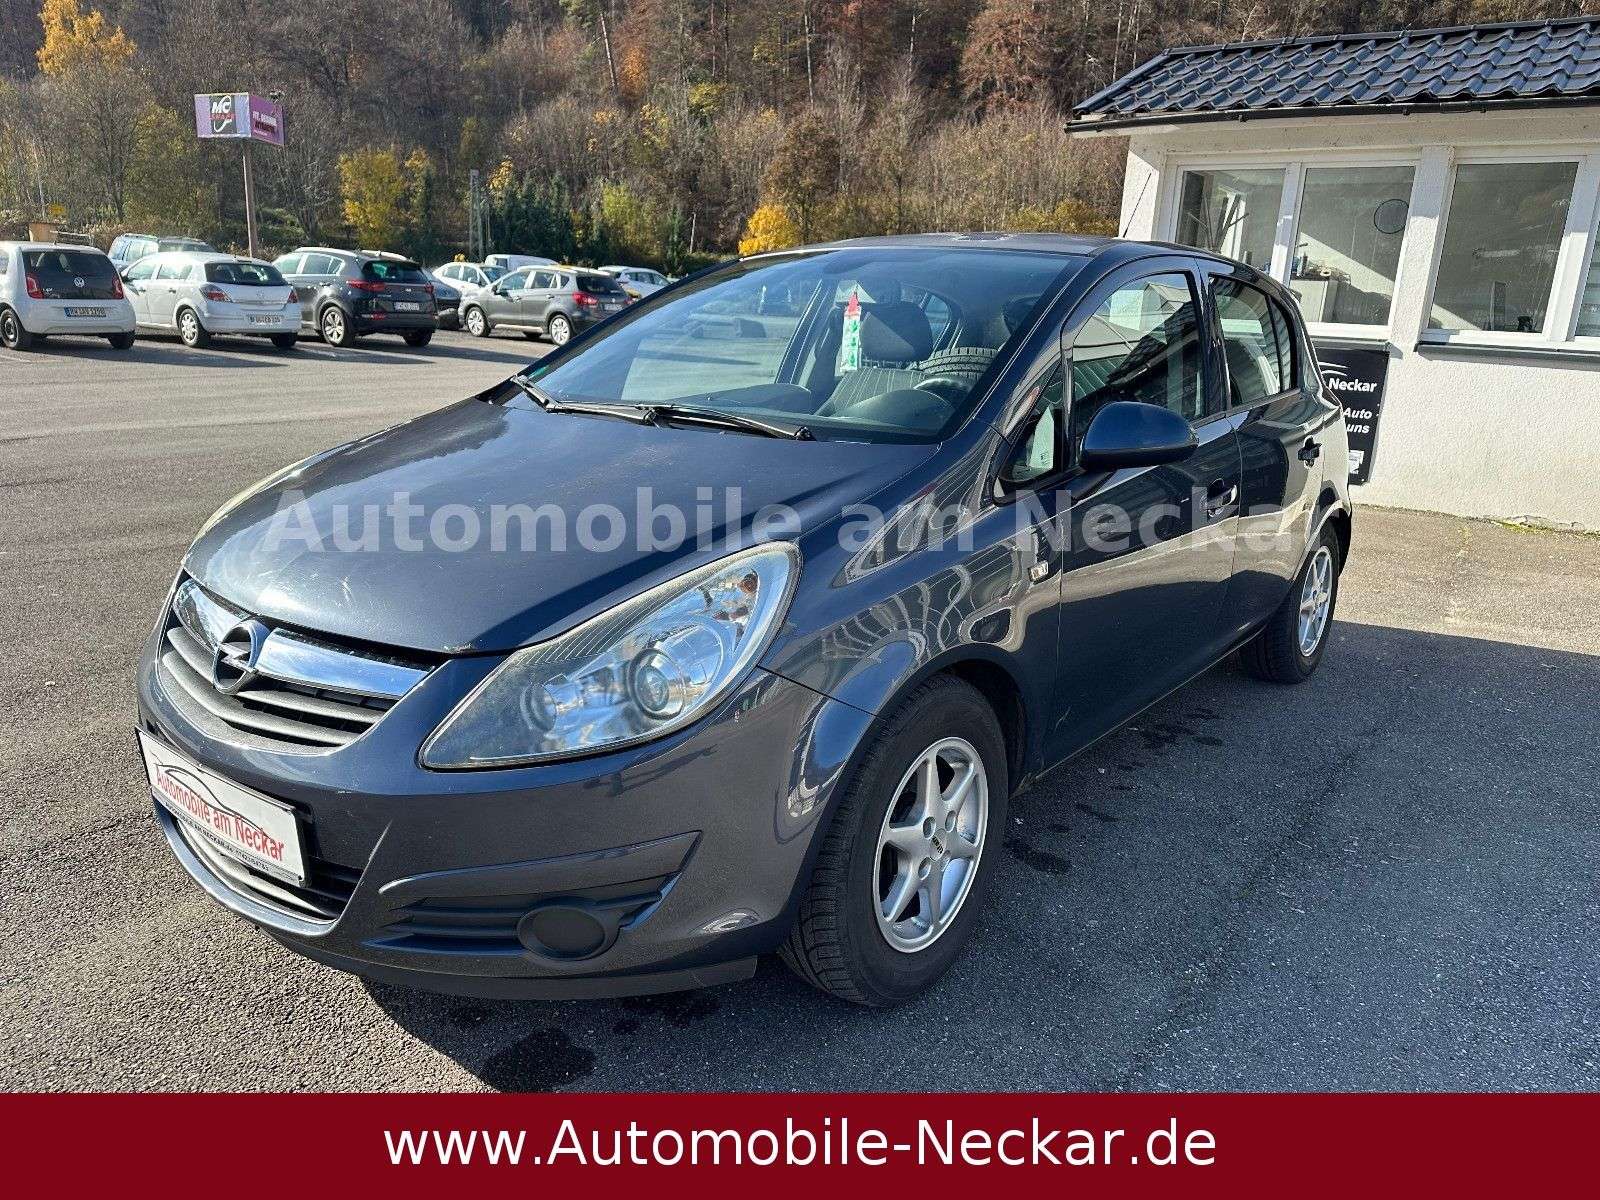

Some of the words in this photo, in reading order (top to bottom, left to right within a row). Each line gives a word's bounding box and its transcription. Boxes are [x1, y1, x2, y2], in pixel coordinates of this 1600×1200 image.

[1328, 377, 1377, 393] Neckar
[1343, 407, 1373, 419] Auto
[1346, 424, 1370, 434] uns
[155, 766, 212, 824] Automobile
[213, 811, 232, 837] am
[235, 815, 285, 861] Neckar
